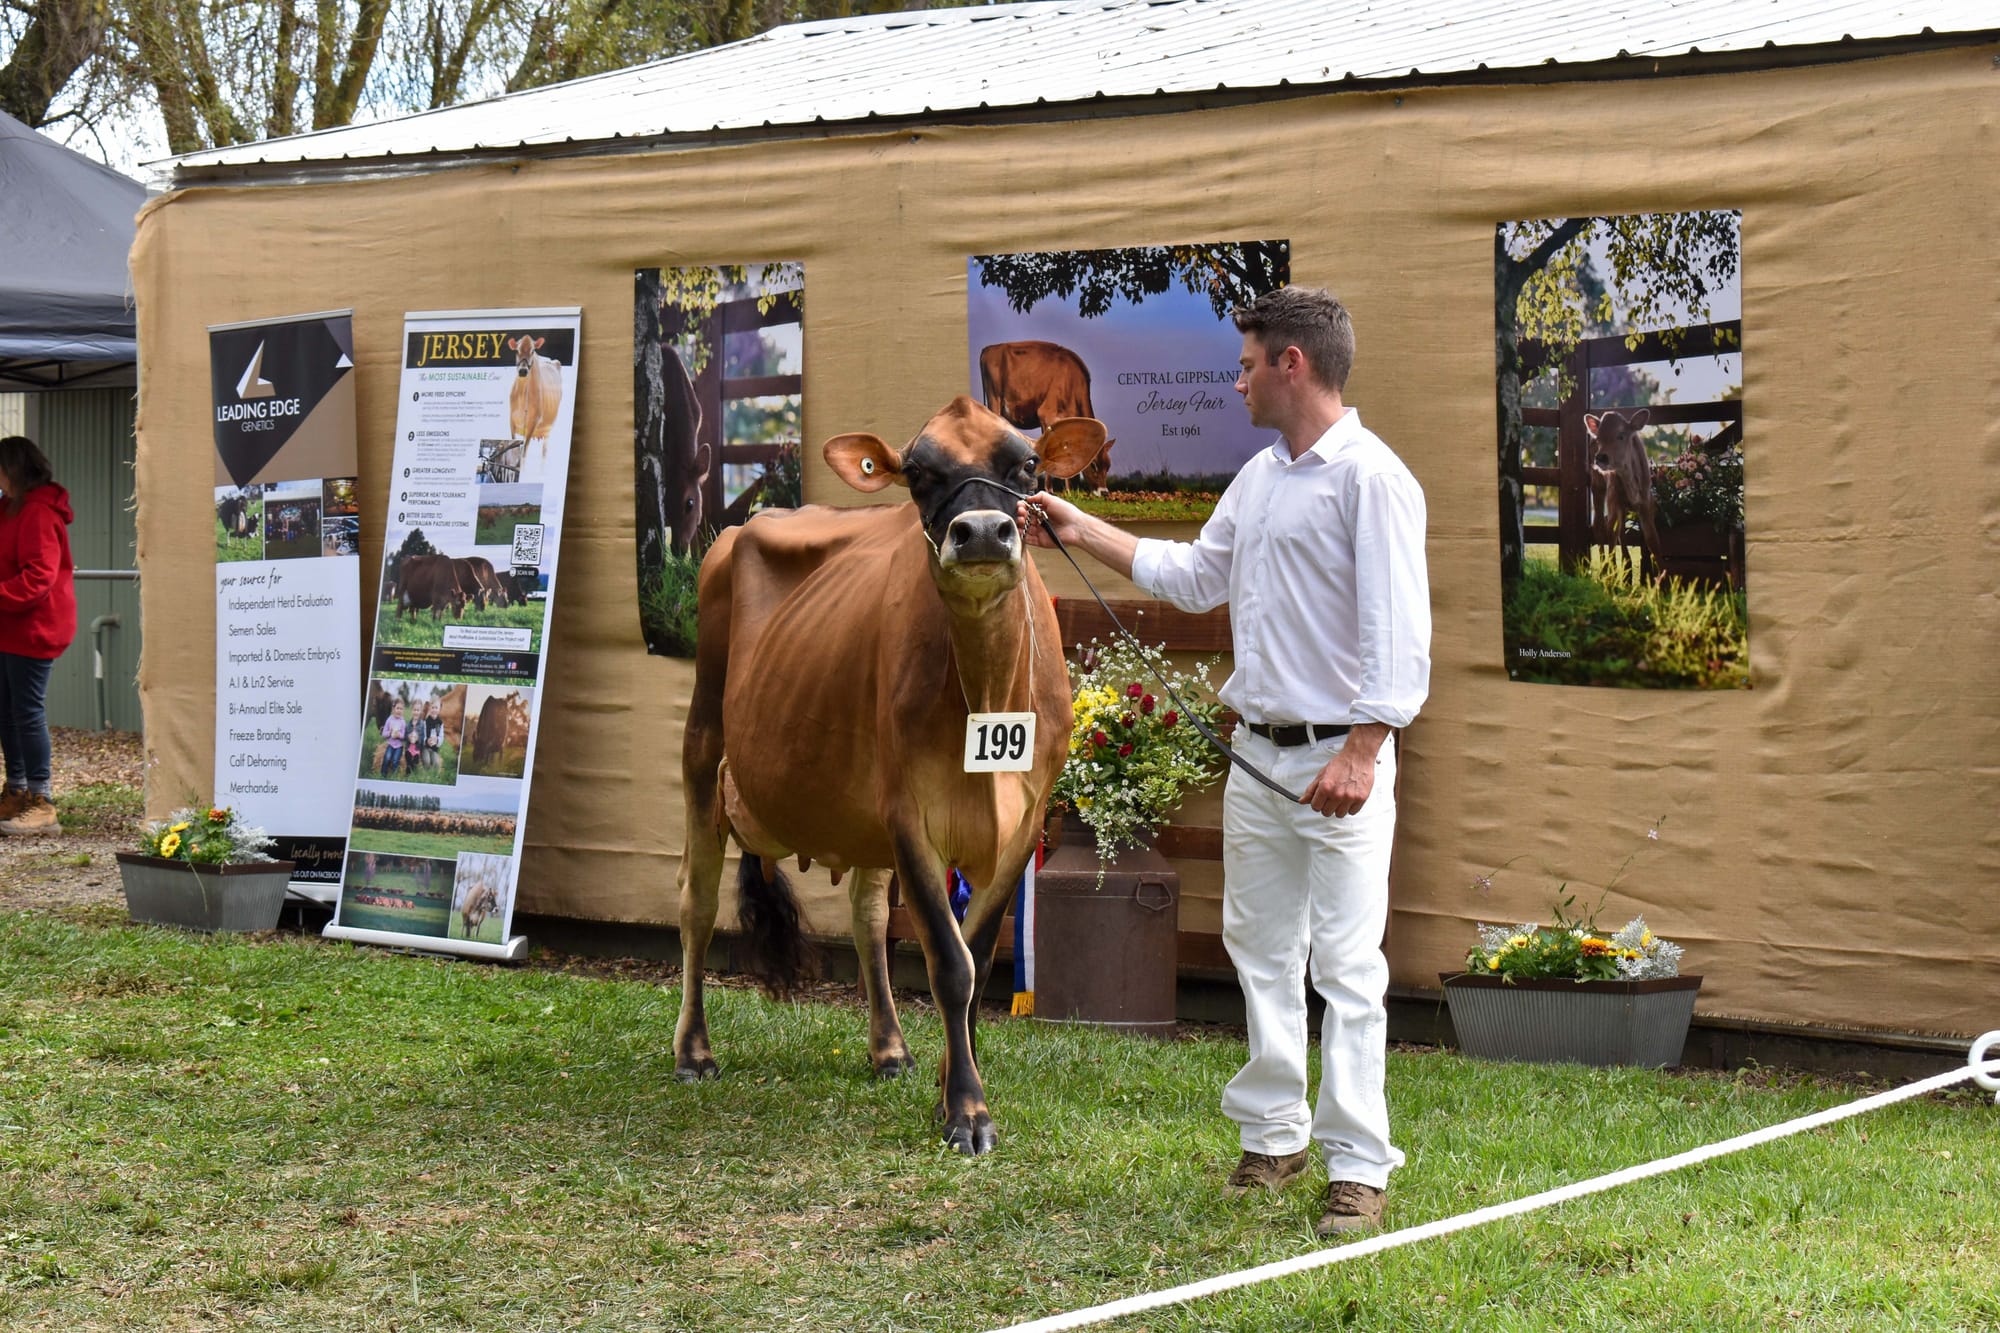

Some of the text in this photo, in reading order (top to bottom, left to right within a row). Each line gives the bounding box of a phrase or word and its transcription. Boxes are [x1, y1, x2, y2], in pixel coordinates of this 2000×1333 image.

[417, 333, 507, 367] JERSEY
[428, 372, 447, 381] MOST
[447, 372, 488, 381] SUSTAINABLE
[1117, 371, 1174, 385] CENTRAL
[217, 398, 301, 421] LEADING EDGE
[1136, 390, 1227, 415] Jersey Fair
[241, 419, 275, 432] GENETICS
[1161, 424, 1201, 438] Est 1961
[219, 567, 283, 594] your source for
[228, 593, 333, 613] Independent Herd Evaluation
[228, 622, 277, 637] Semen Sales
[228, 647, 341, 666] Imported & Domestic Embryo's
[1519, 648, 1571, 659] Holly Anderson
[228, 675, 294, 689] A.I & Ln2 Service
[229, 700, 303, 715] Bi-Annual Elite Sale
[229, 727, 291, 744] Freeze Branding
[975, 723, 1026, 760] 199
[229, 754, 287, 770] Calf Dehorning
[230, 780, 279, 794] Merchandise
[290, 843, 344, 867] locally owne
[319, 871, 341, 879] FACEBOO
